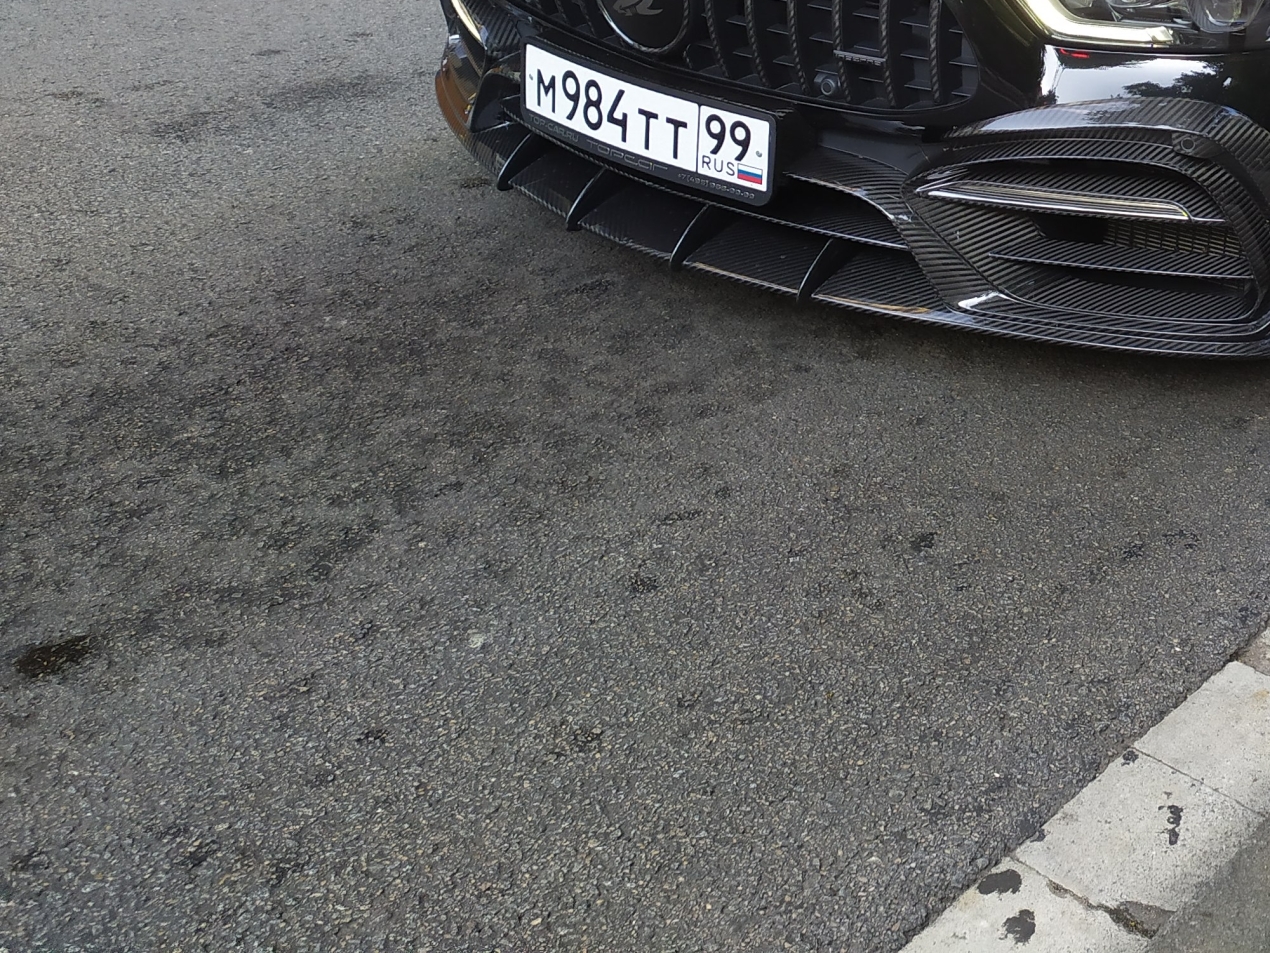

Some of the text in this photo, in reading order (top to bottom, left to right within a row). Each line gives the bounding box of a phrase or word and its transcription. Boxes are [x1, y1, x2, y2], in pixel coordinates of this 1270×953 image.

[536, 68, 752, 162] M984TT 99
[701, 154, 736, 177] RUS
